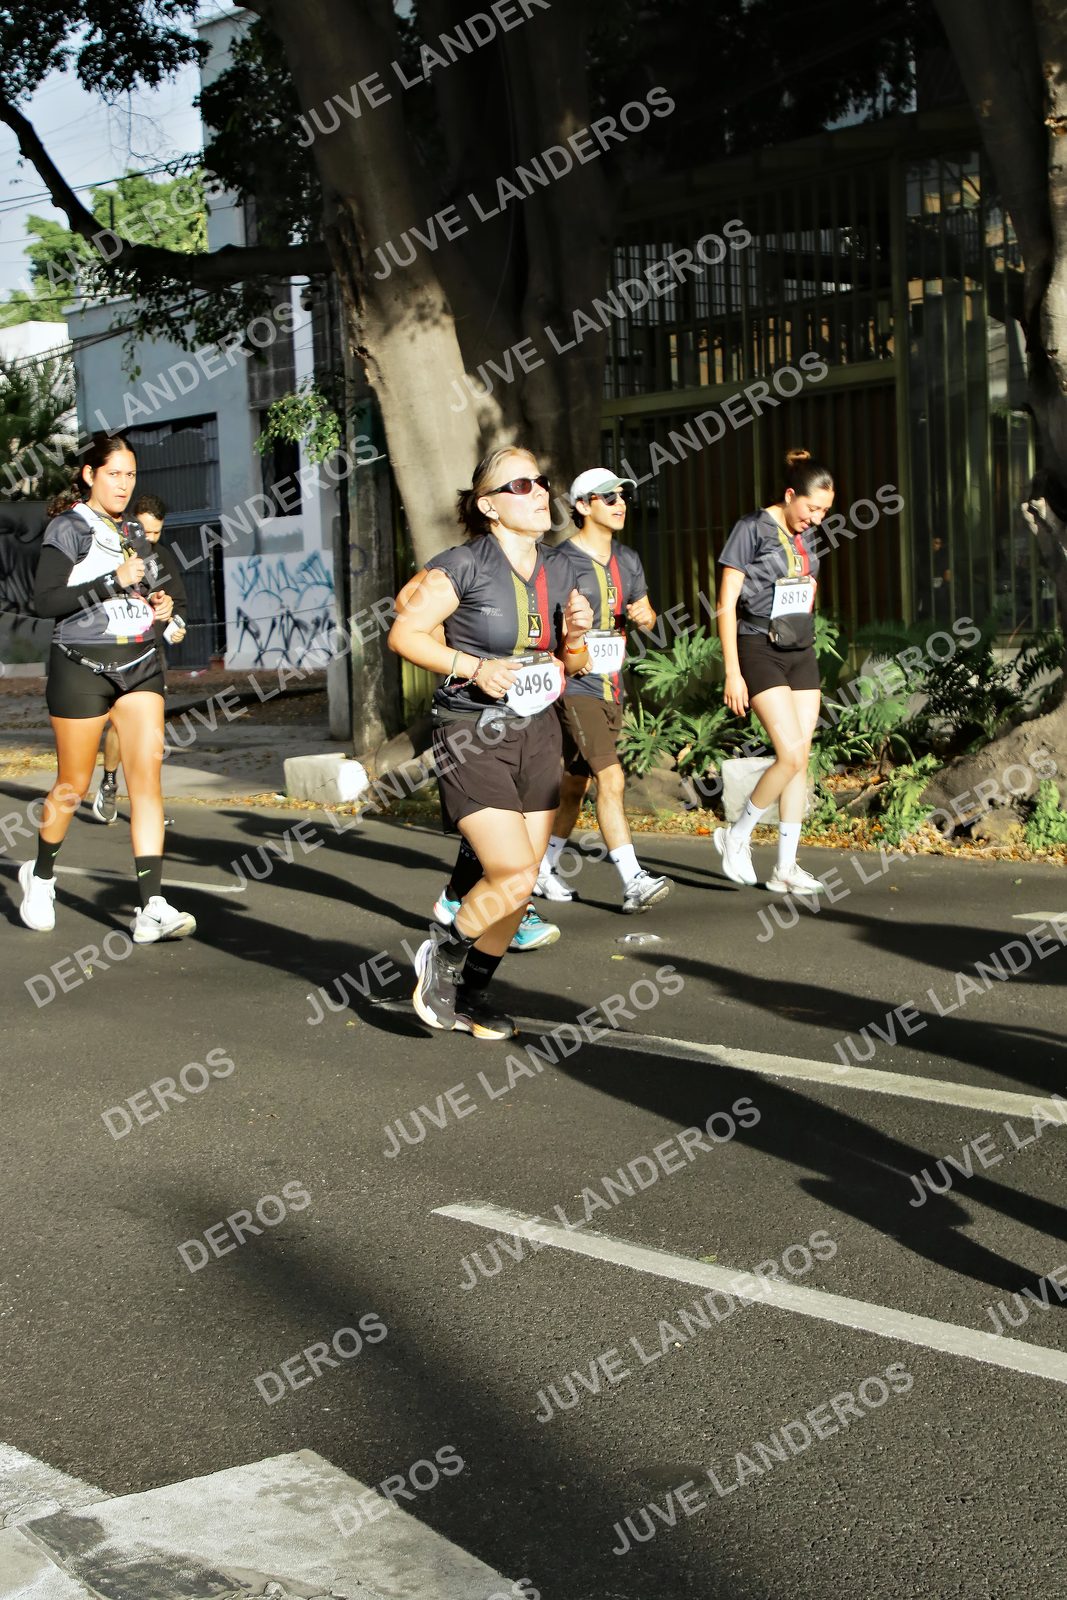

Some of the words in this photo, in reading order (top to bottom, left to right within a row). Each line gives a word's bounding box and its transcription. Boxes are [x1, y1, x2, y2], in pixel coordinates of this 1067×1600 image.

[781, 590, 808, 605] 8818
[593, 643, 619, 658] 9501
[513, 672, 553, 696] 8496
